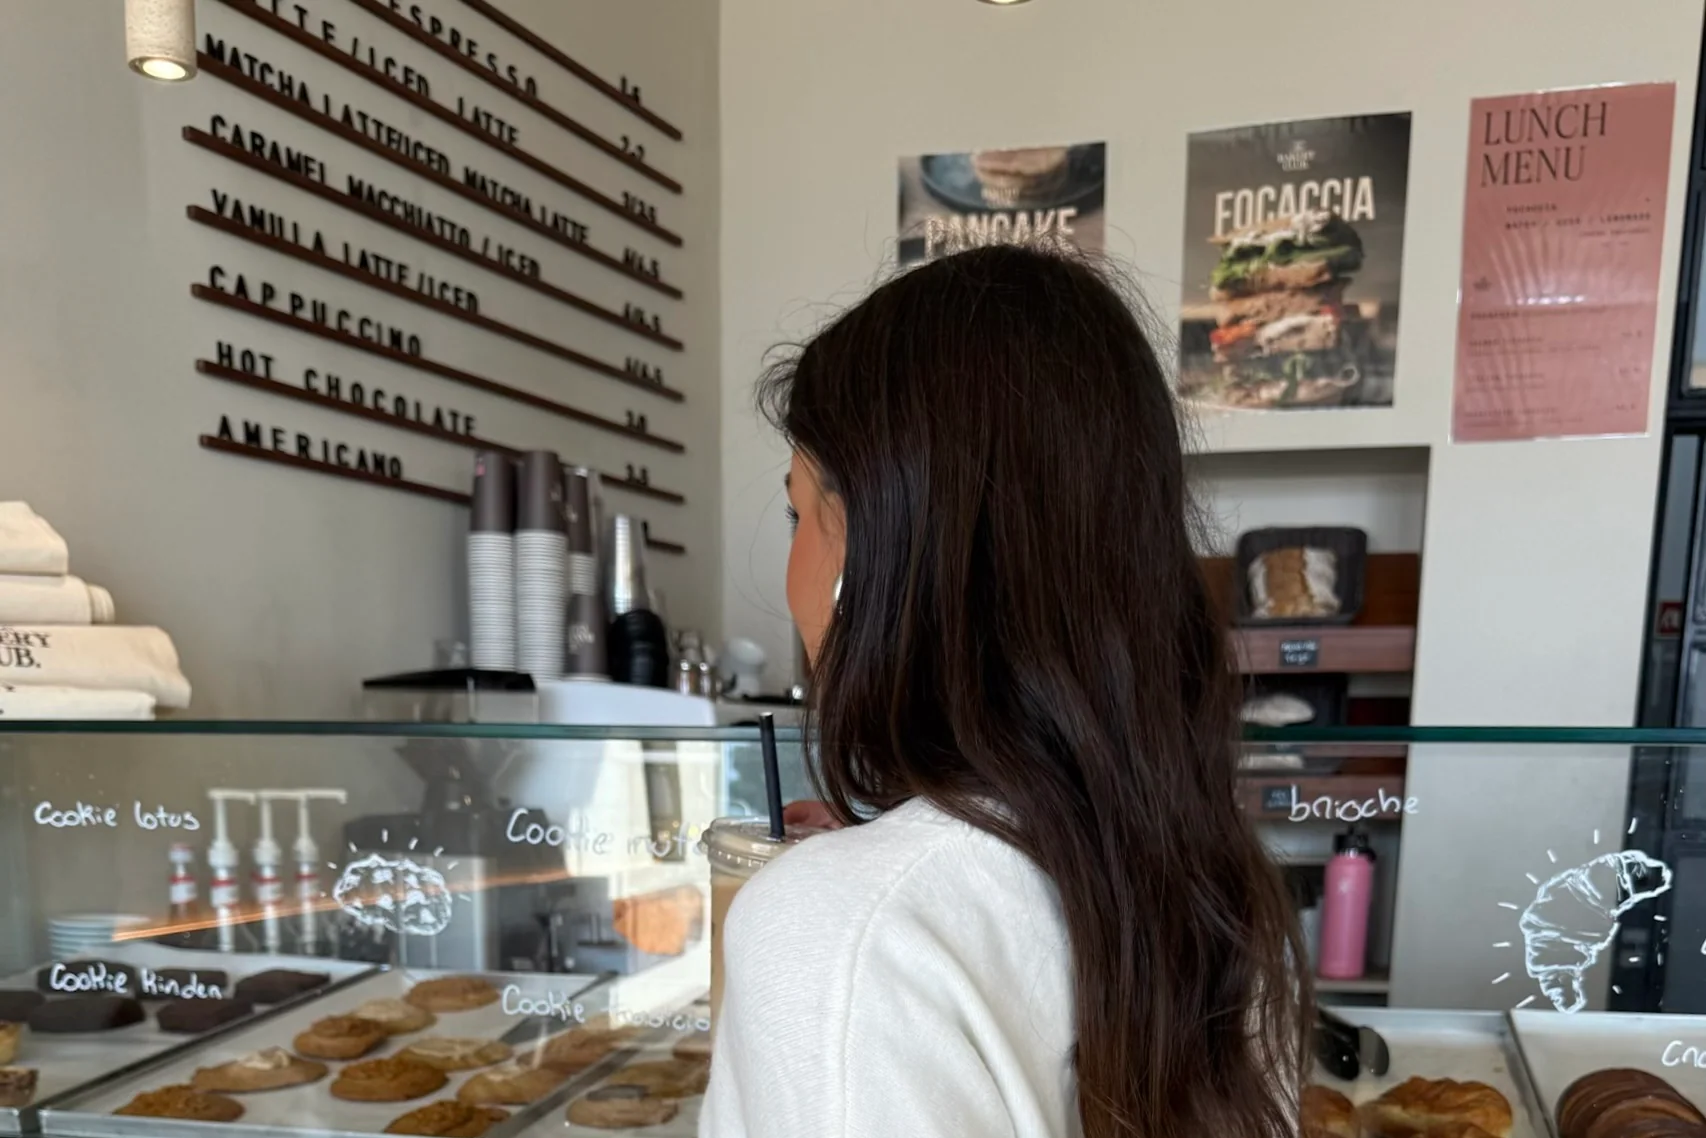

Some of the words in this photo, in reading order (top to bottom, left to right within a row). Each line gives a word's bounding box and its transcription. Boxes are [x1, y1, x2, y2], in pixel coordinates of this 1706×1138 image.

[205, 33, 312, 109] MATCHA
[463, 166, 535, 220] MATCHA
[540, 206, 590, 247] LATTE
[457, 97, 519, 145] LATTE
[1483, 101, 1608, 146] LUNCH
[210, 115, 326, 185] CARAMEL
[347, 174, 470, 247] MACCHIATTO
[1480, 145, 1587, 188] MENU
[923, 206, 1078, 262] PANCAKE
[1213, 176, 1376, 238] FOCACCIA
[211, 188, 326, 257] VANILLA
[344, 242, 409, 287] LATTE
[208, 265, 421, 358] CAPPUCCINO
[216, 341, 274, 381] HOT
[303, 369, 476, 437] CHOCOLATE
[218, 416, 403, 480] AMERICANO
[34, 800, 119, 828] Cookie
[134, 800, 200, 831] lotus
[1288, 784, 1419, 822] brioche
[50, 962, 128, 994] Cookie
[502, 984, 586, 1024] Cookie
